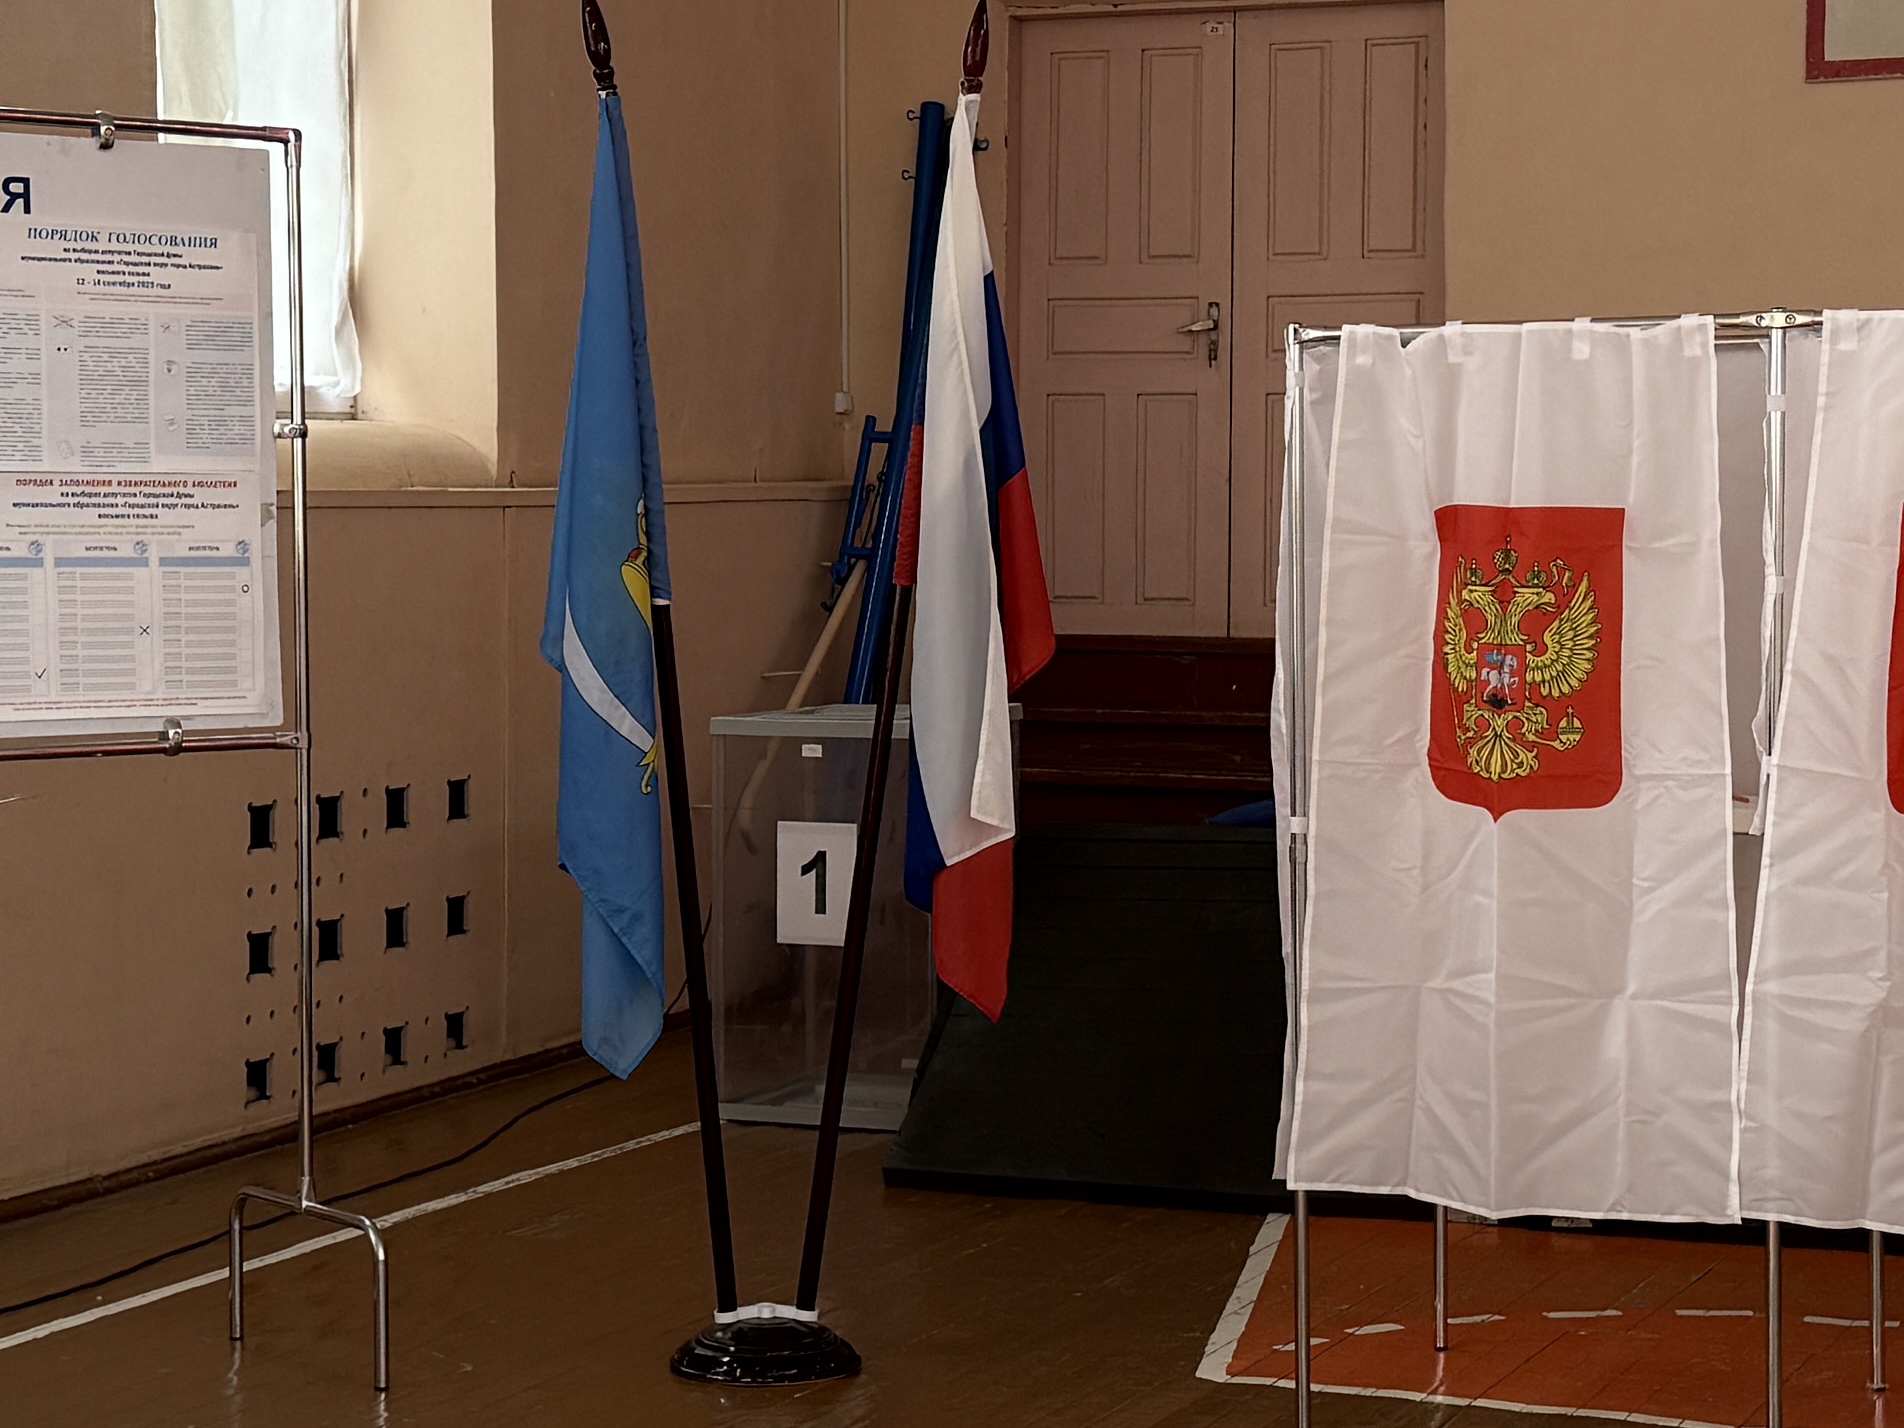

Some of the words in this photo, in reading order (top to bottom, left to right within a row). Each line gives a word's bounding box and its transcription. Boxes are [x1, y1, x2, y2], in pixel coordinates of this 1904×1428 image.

[27, 227, 101, 243] ПОРЯДОК
[108, 232, 218, 249] ГОЛОСОВАНИЯ
[16, 478, 54, 487] ПОРЯДОК
[800, 850, 827, 915] 1
